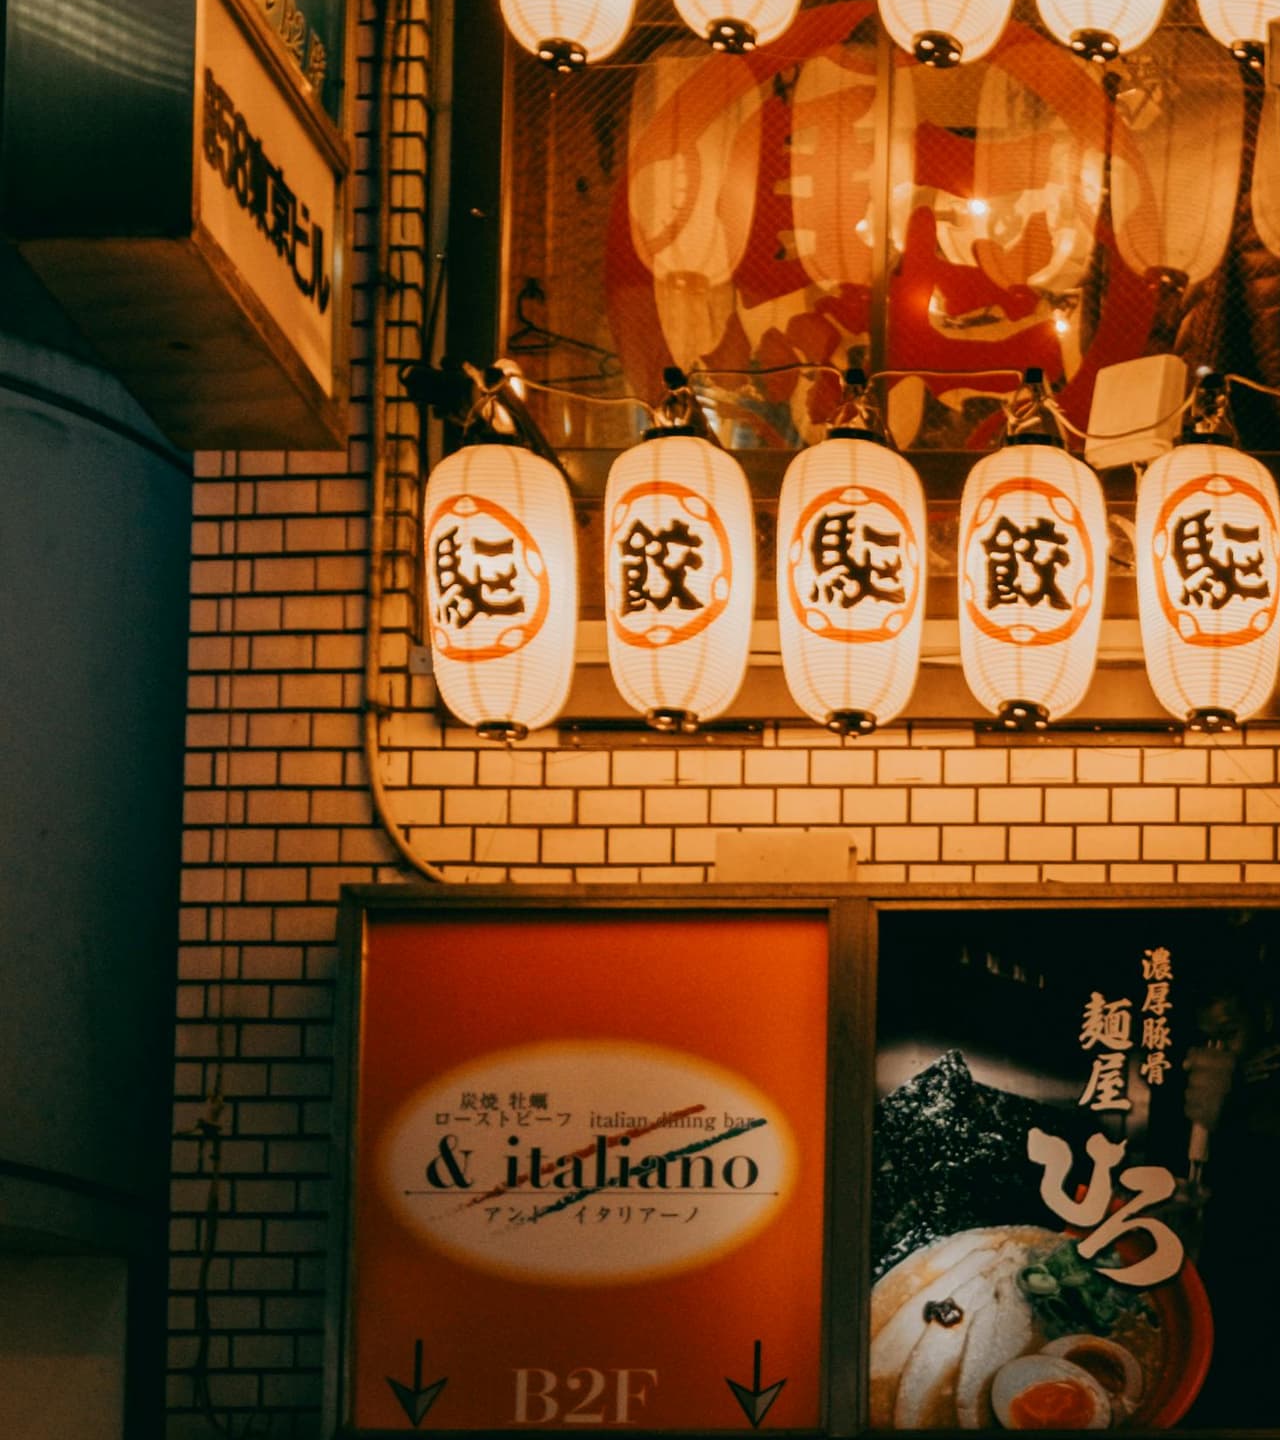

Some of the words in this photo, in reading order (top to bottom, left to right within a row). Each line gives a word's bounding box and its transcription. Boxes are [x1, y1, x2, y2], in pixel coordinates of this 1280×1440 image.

[1139, 946, 1175, 1087] 濃厚豚骨
[1078, 990, 1135, 1113] 麺屋
[434, 1112, 573, 1128] ローストビーフ
[590, 1110, 648, 1128] italian
[425, 1134, 475, 1190] &
[506, 1134, 759, 1190] italiano
[575, 1206, 699, 1225] イタリアーノ
[1026, 1126, 1186, 1288] ひろ
[512, 1366, 660, 1427] B2F
